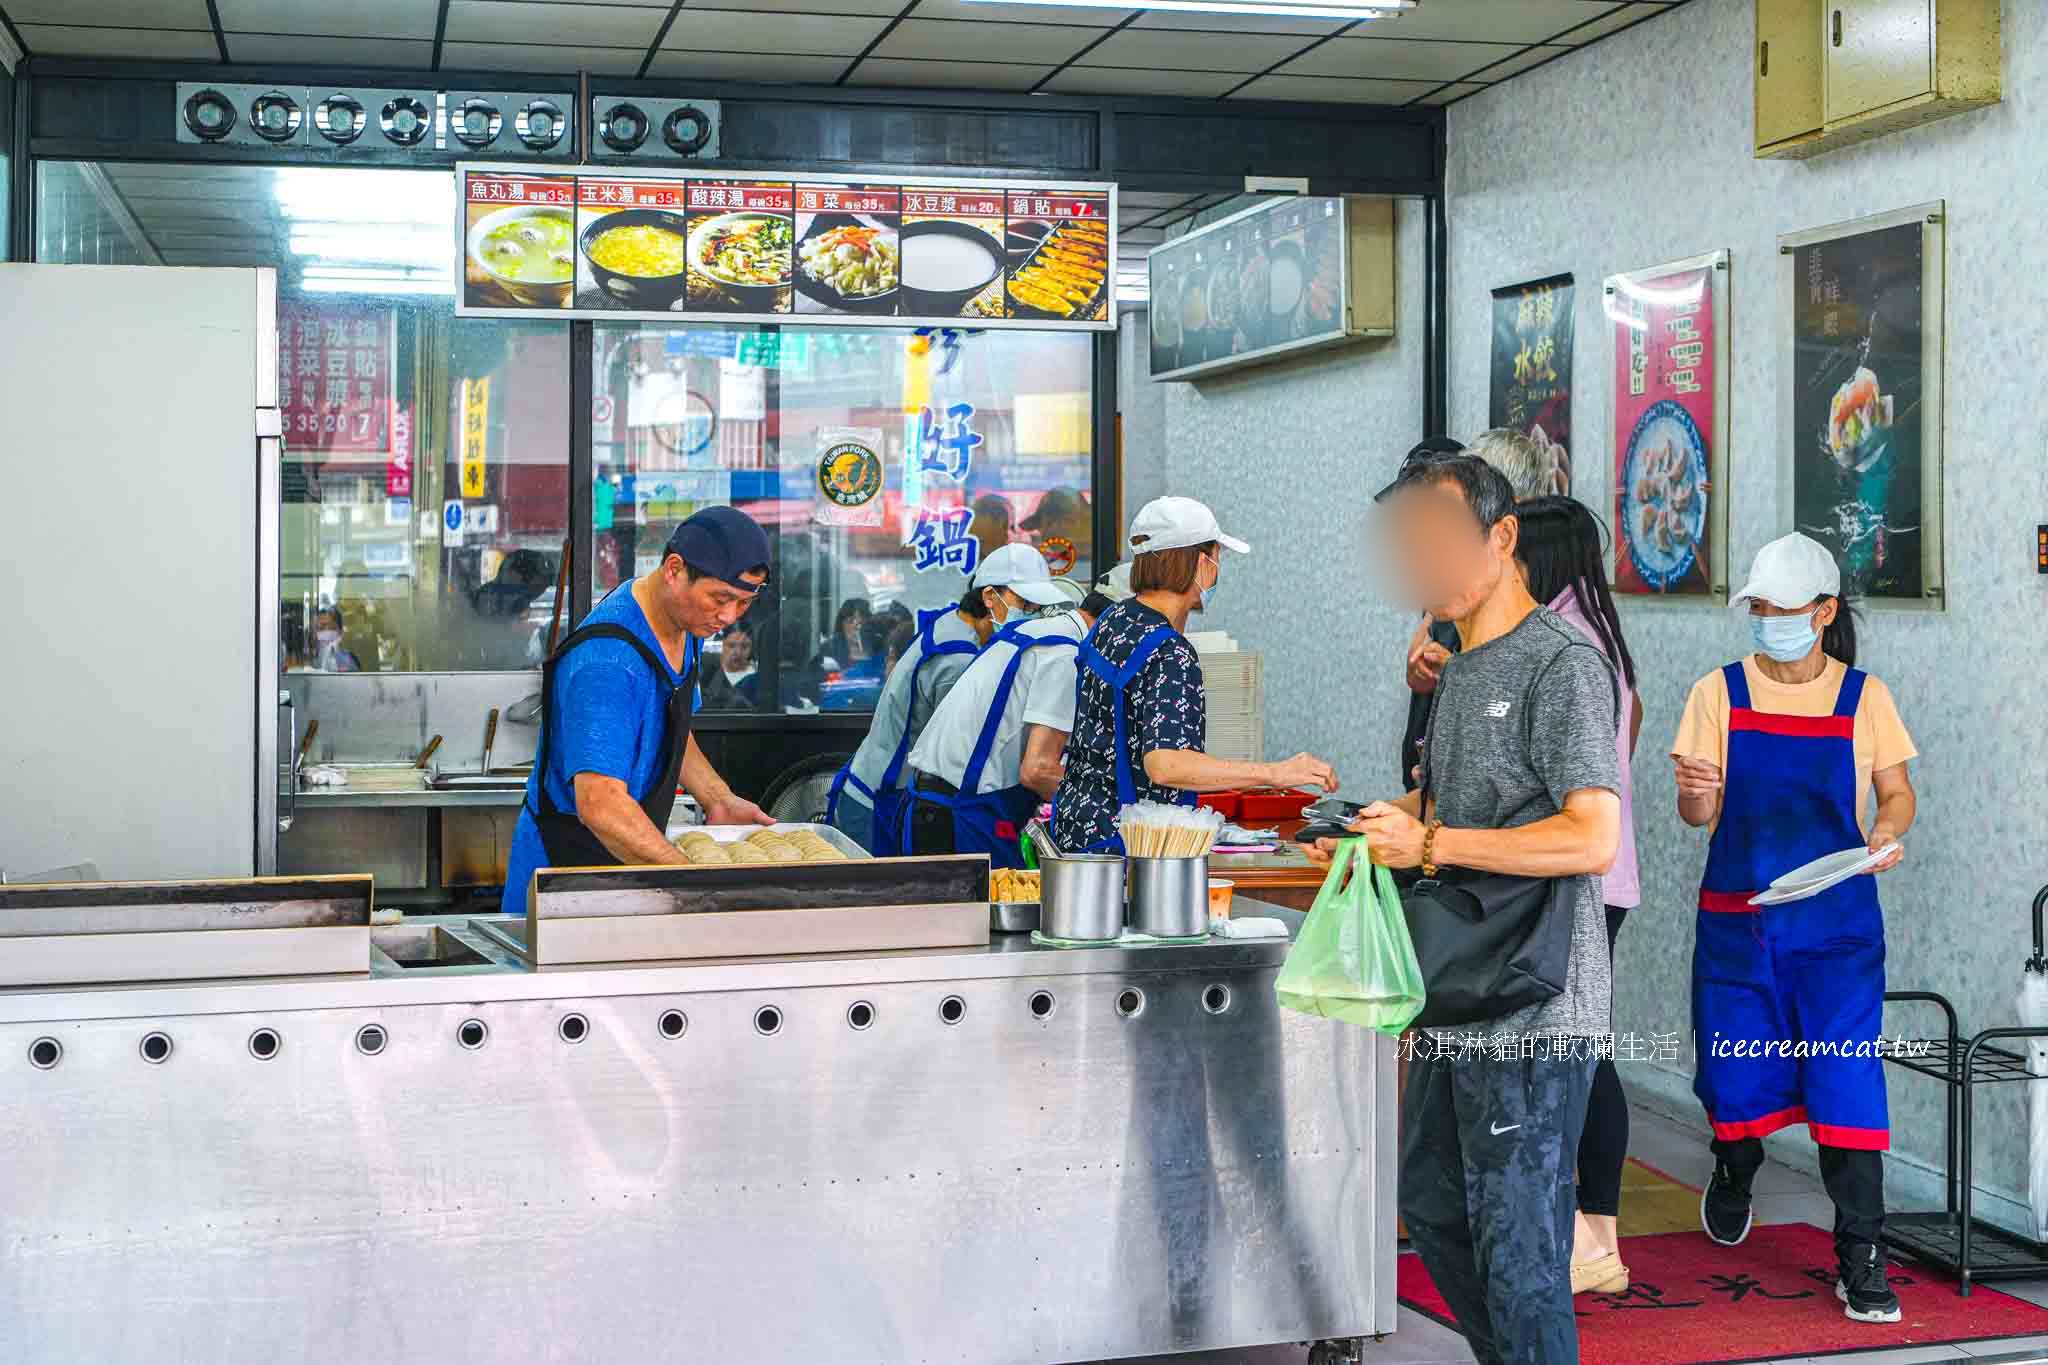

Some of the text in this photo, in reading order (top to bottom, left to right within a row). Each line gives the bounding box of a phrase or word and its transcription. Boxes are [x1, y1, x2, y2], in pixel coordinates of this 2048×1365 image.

[472, 182, 525, 200] 魚丸湯
[582, 185, 634, 203] 玉米湯
[691, 189, 744, 206] 酸辣湯
[800, 191, 840, 209] 泡菜
[905, 195, 957, 212] 冰豆漿
[1013, 198, 1052, 215] 鍋貼
